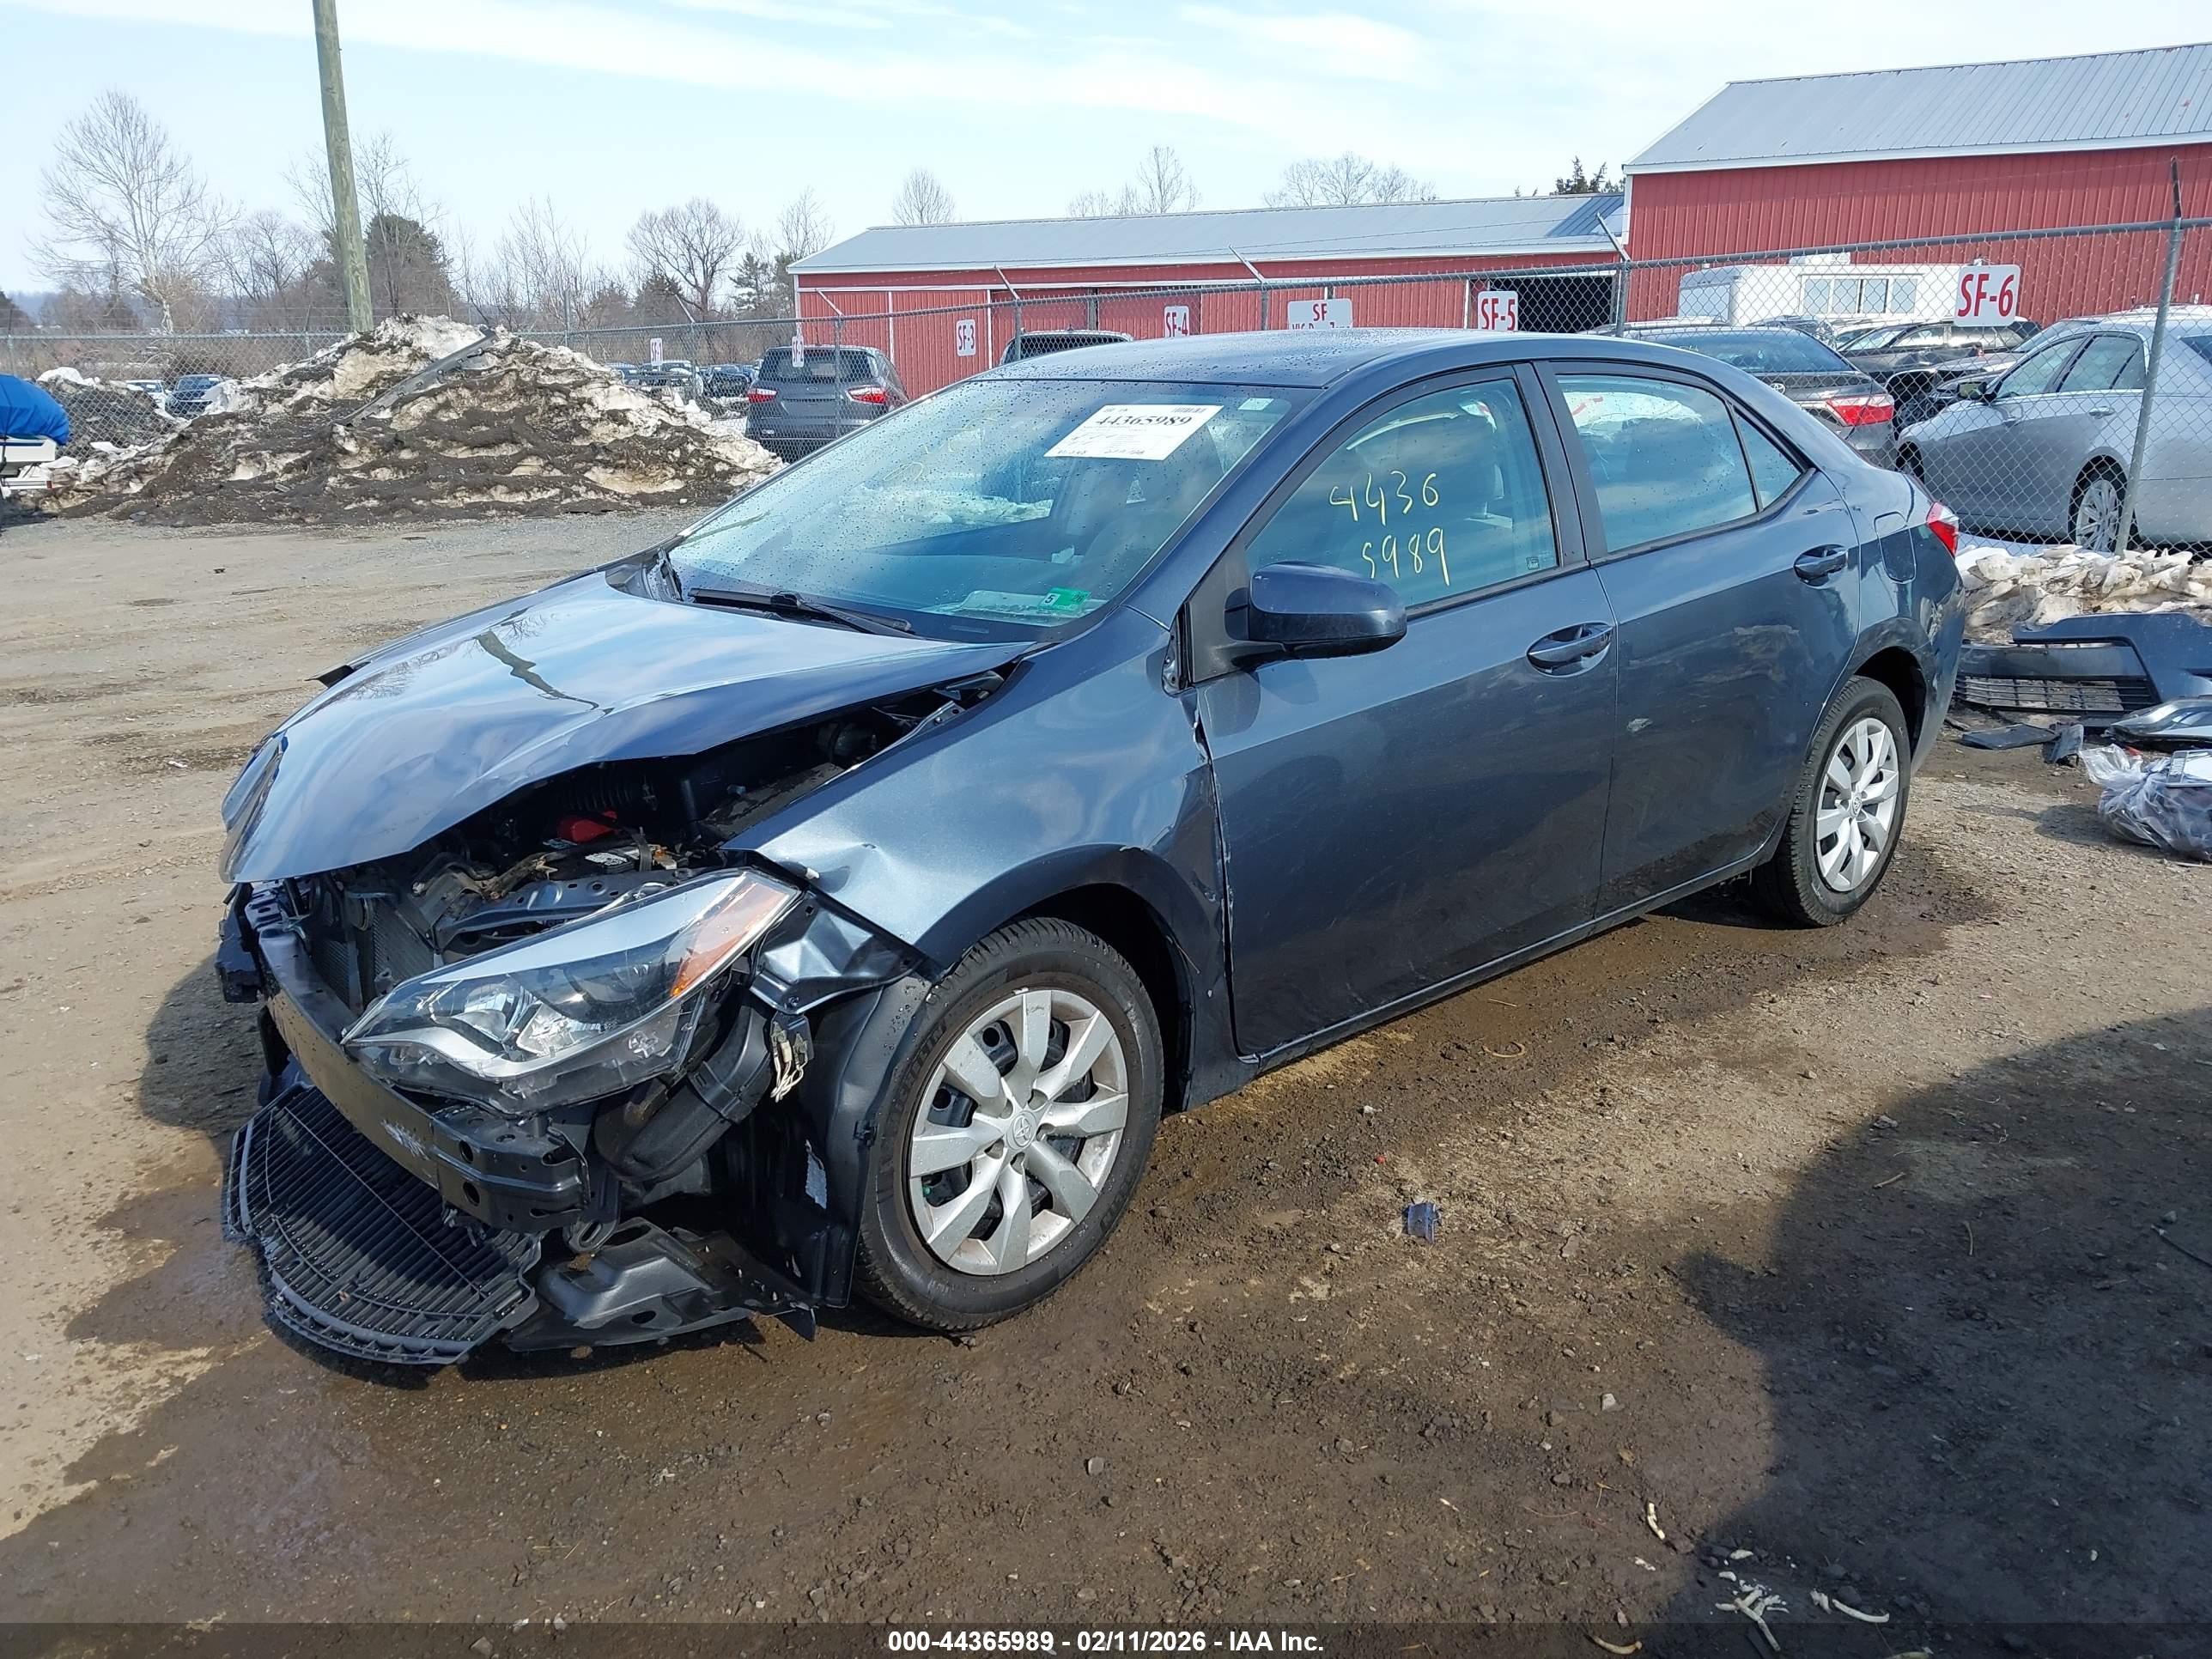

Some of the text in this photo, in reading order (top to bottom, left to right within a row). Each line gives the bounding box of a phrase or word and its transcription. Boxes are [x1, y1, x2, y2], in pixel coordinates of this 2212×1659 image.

[1957, 273, 2014, 318] SF-6
[1165, 312, 1188, 337] SF-4
[1312, 303, 1328, 321] SF
[1481, 297, 1516, 331] SF-5
[957, 325, 975, 351] SF-3
[1096, 416, 1194, 426] 44365989
[1328, 470, 1440, 526] 4436
[1360, 526, 1450, 586] 5989
[1044, 594, 1056, 604] 5
